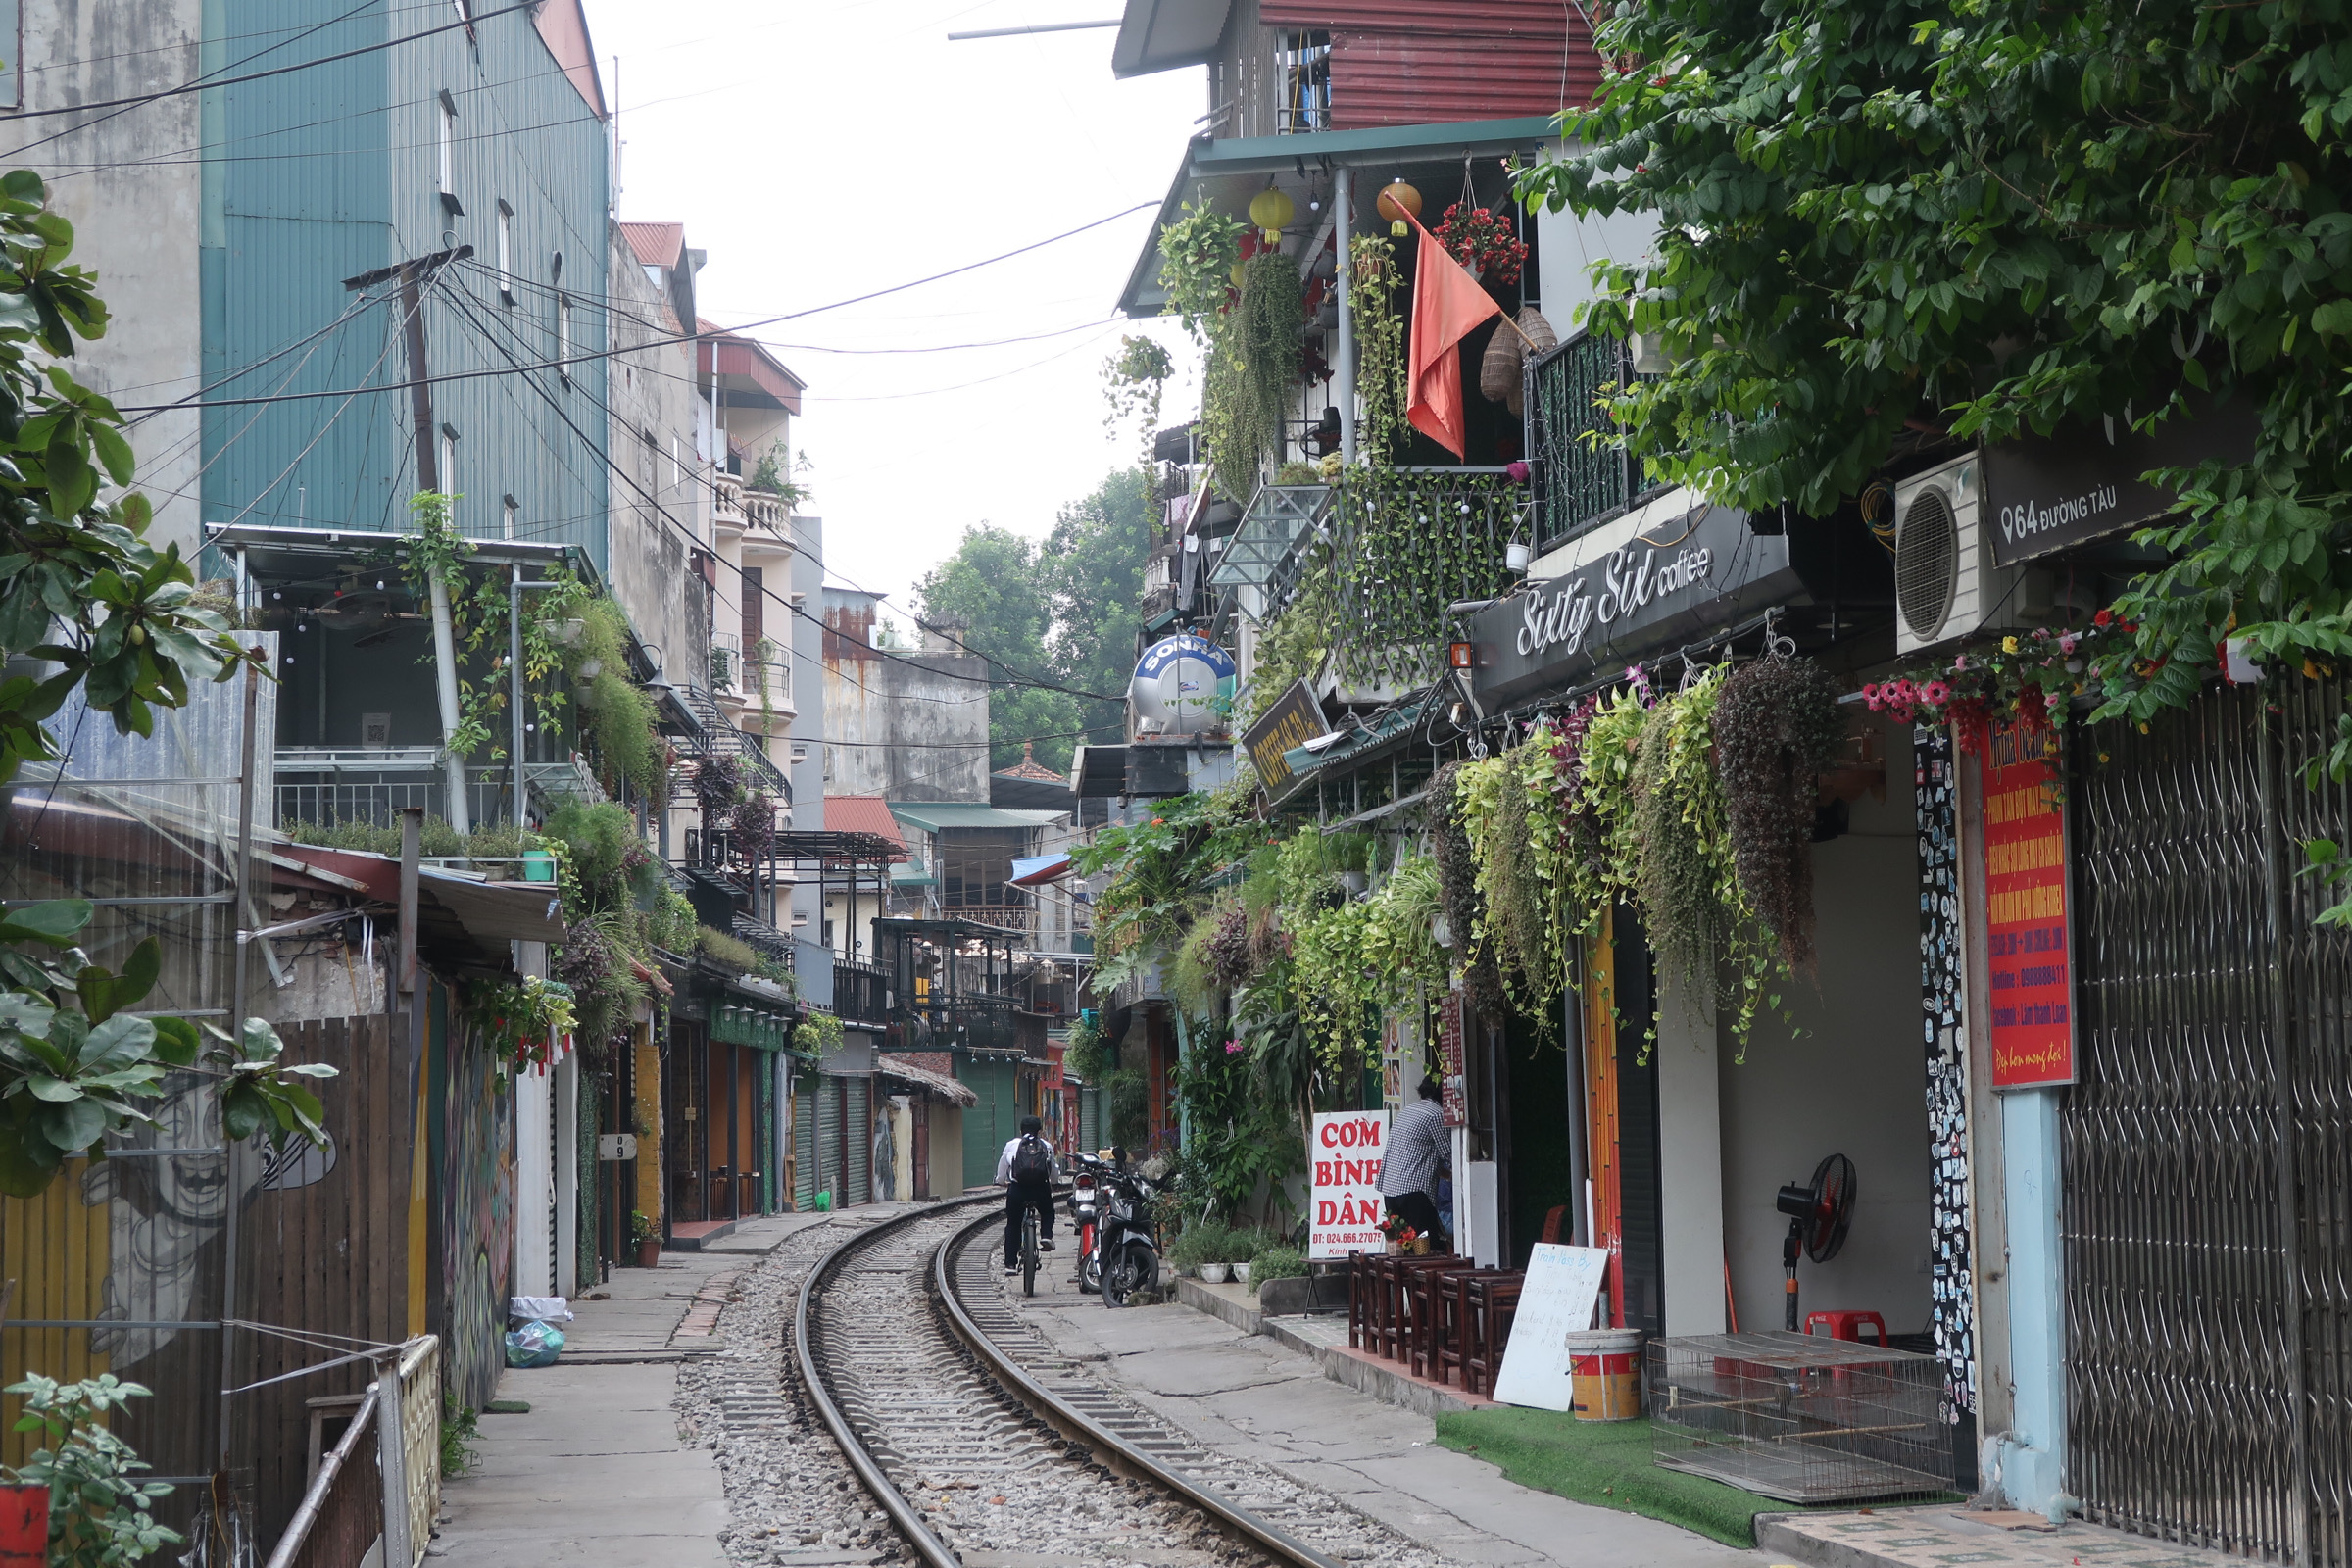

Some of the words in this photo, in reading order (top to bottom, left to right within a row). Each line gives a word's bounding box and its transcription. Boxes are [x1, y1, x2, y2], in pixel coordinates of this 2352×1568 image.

[2015, 500, 2037, 539] 64
[2040, 497, 2088, 531] ĐƯỜNG
[2089, 484, 2117, 514] TÀU
[1516, 577, 1593, 657] Sixty
[1597, 548, 1657, 624] Six
[1657, 547, 1713, 598] coffee
[1253, 728, 1292, 787] COFFEE
[1315, 1153, 1383, 1187] BÌNH
[1317, 1192, 1380, 1226] DÂN
[1536, 1248, 1556, 1264] Train
